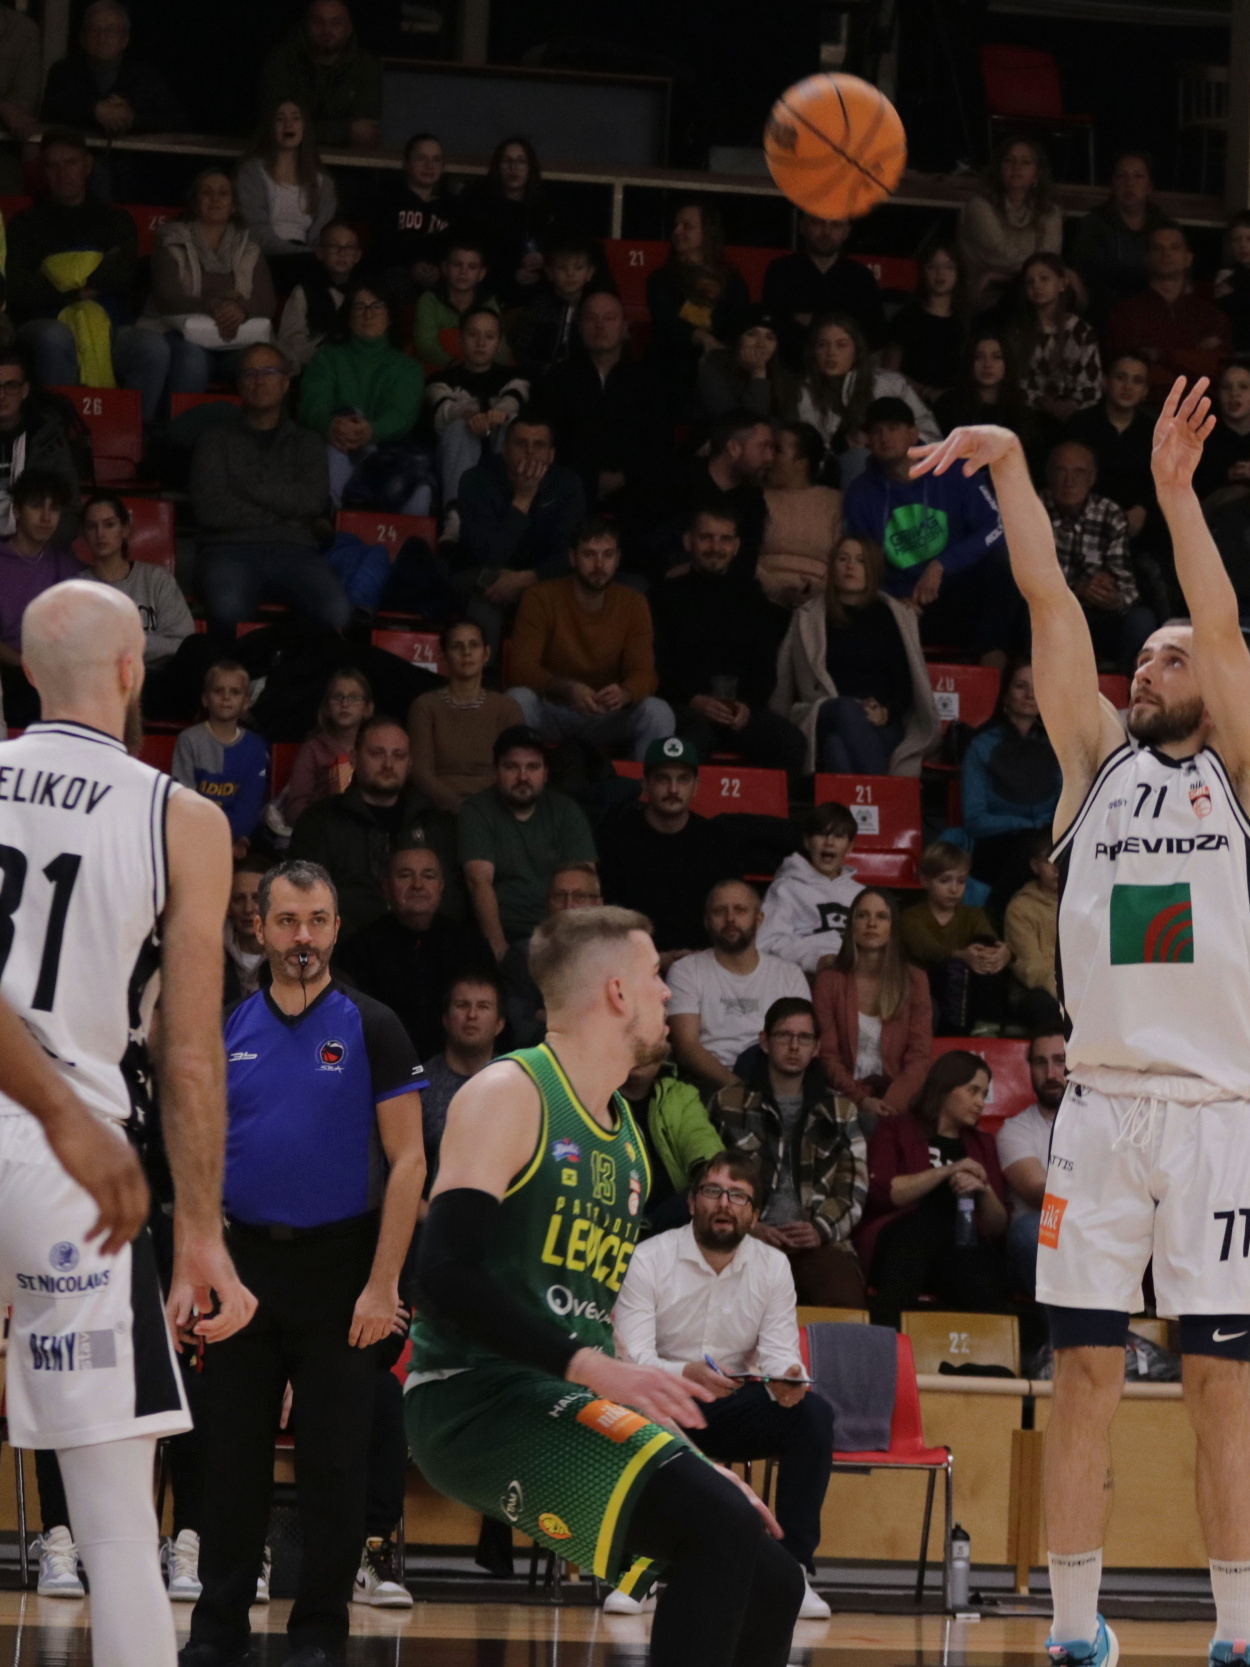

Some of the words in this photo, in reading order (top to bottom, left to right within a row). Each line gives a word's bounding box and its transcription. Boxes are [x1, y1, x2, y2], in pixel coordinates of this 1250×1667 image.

[629, 250, 645, 267] 21
[82, 397, 103, 416] 26
[377, 524, 397, 543] 24
[413, 643, 434, 662] 24
[720, 777, 741, 798] 22
[855, 784, 872, 804] 21
[590, 1150, 617, 1206] 13
[948, 1331, 971, 1355] 22
